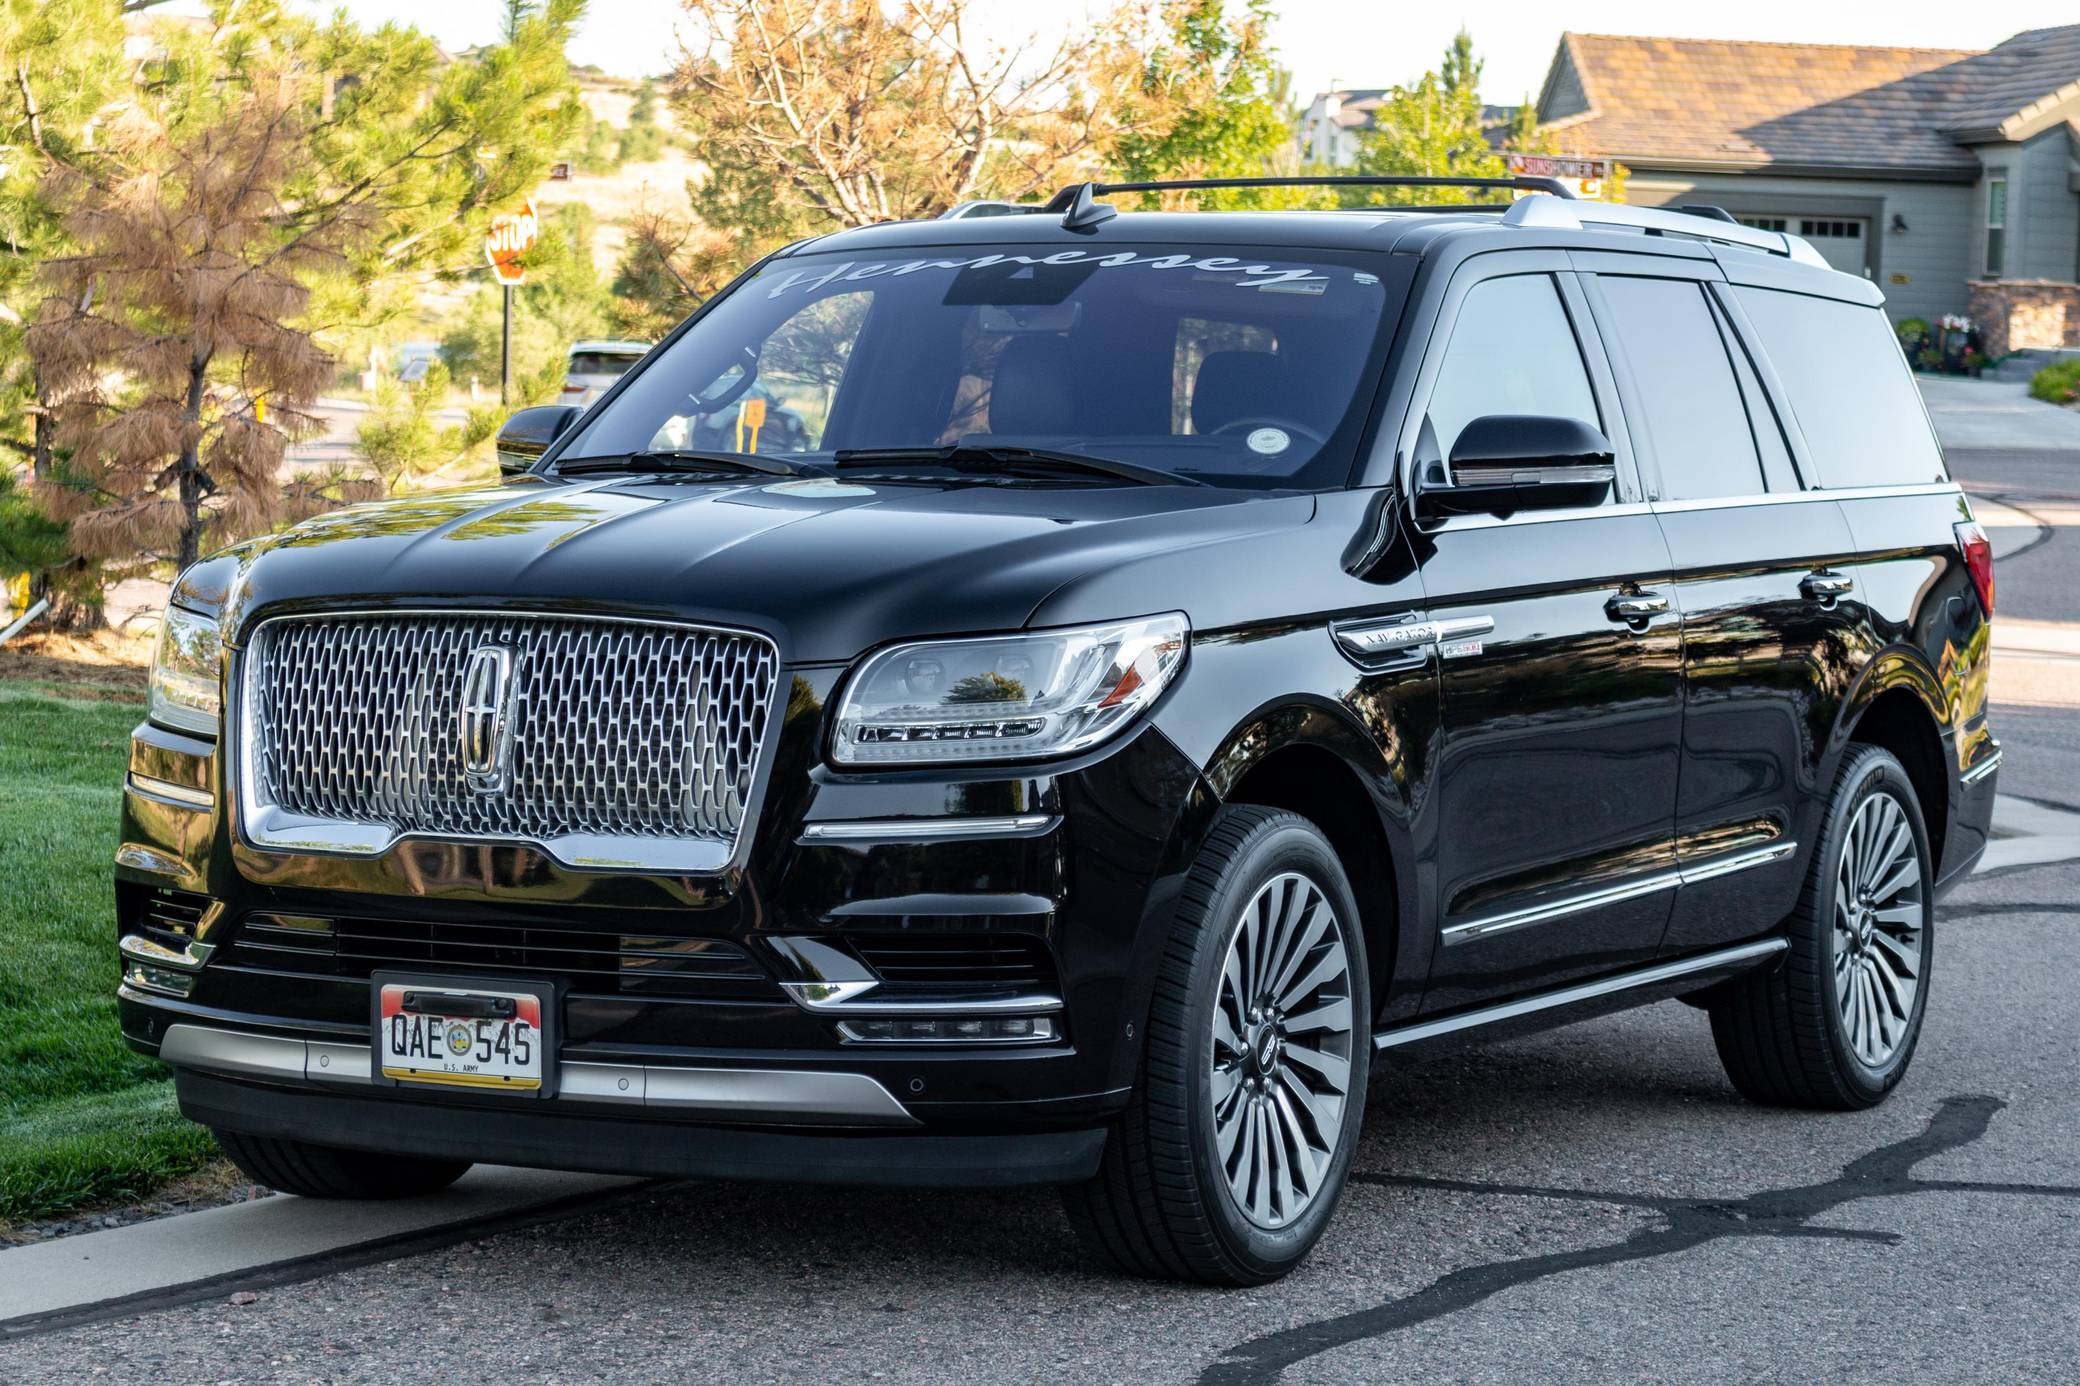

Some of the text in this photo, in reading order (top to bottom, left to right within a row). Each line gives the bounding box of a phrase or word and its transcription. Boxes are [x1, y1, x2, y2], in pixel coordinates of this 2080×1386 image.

[490, 215, 534, 251] STOP
[768, 251, 1329, 299] Hennessey
[392, 1015, 530, 1065] QAE 545
[444, 1063, 479, 1073] U.S. ARMY
